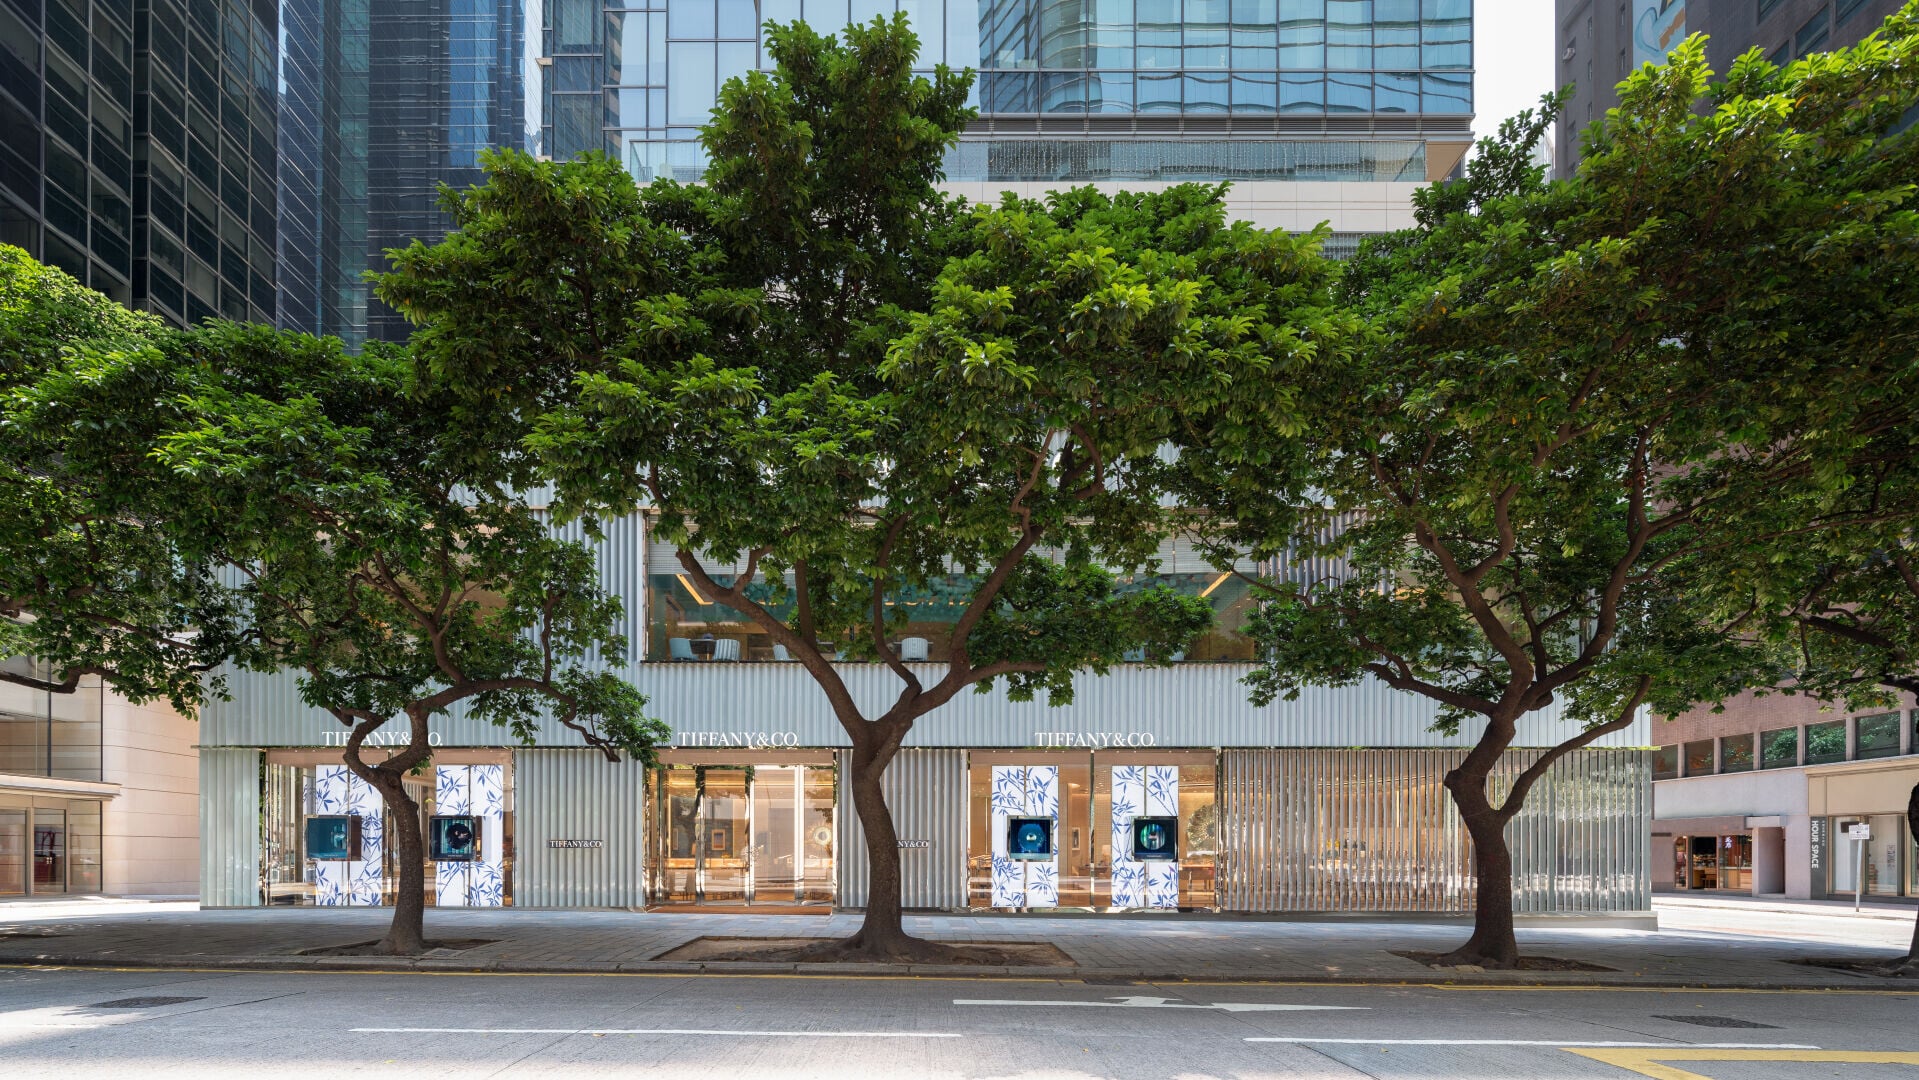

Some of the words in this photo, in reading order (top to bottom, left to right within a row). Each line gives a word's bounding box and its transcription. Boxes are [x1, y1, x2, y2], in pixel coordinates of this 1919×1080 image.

[321, 731, 443, 746] TIFANY&O.
[678, 731, 799, 747] TIFFANY&CO.
[1035, 732, 1157, 747] TIFFANY&CO.
[1811, 820, 1819, 842] HOUR
[896, 840, 929, 848] NY&CO
[1811, 845, 1819, 868] SPACE
